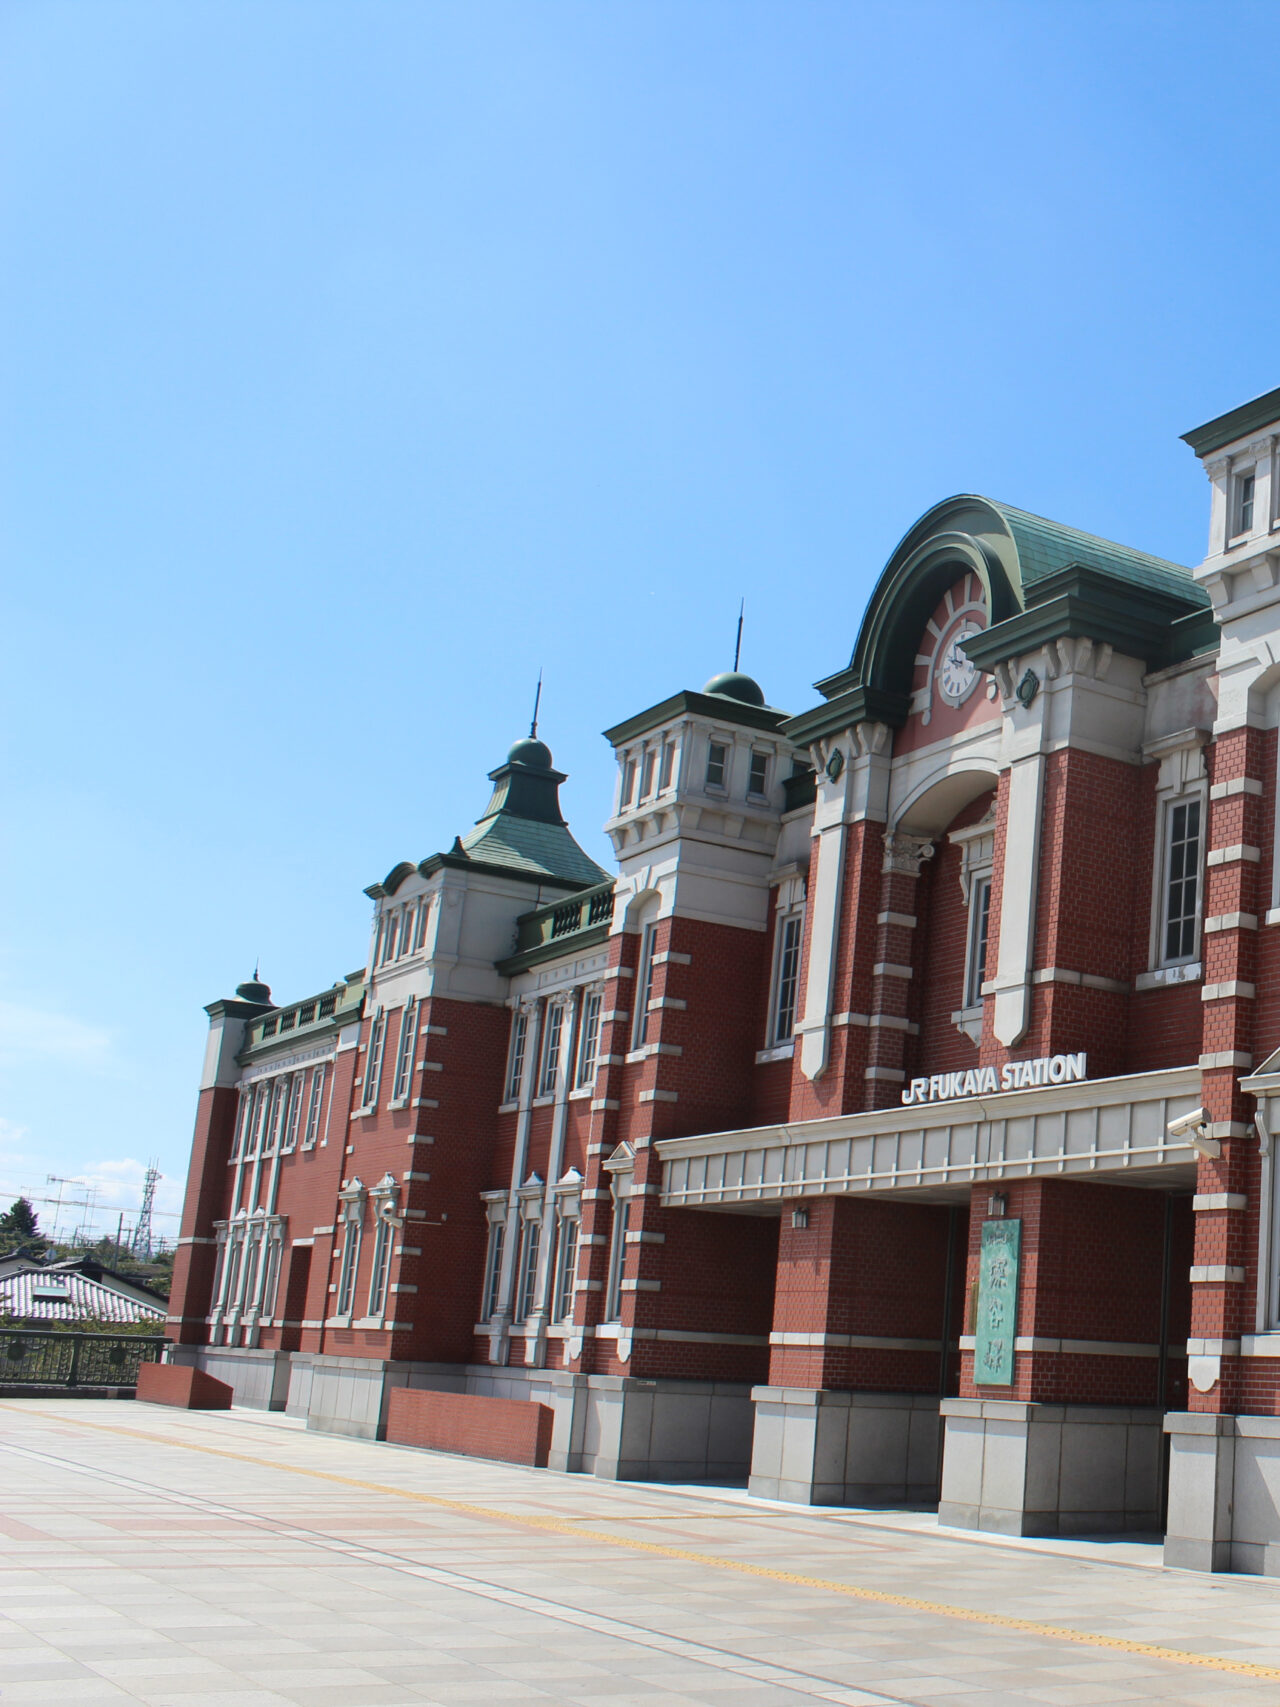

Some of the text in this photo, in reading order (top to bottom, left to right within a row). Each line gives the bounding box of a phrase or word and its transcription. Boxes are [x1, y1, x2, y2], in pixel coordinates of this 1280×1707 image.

[902, 1052, 1088, 1104] JR FUKAYA STATION
